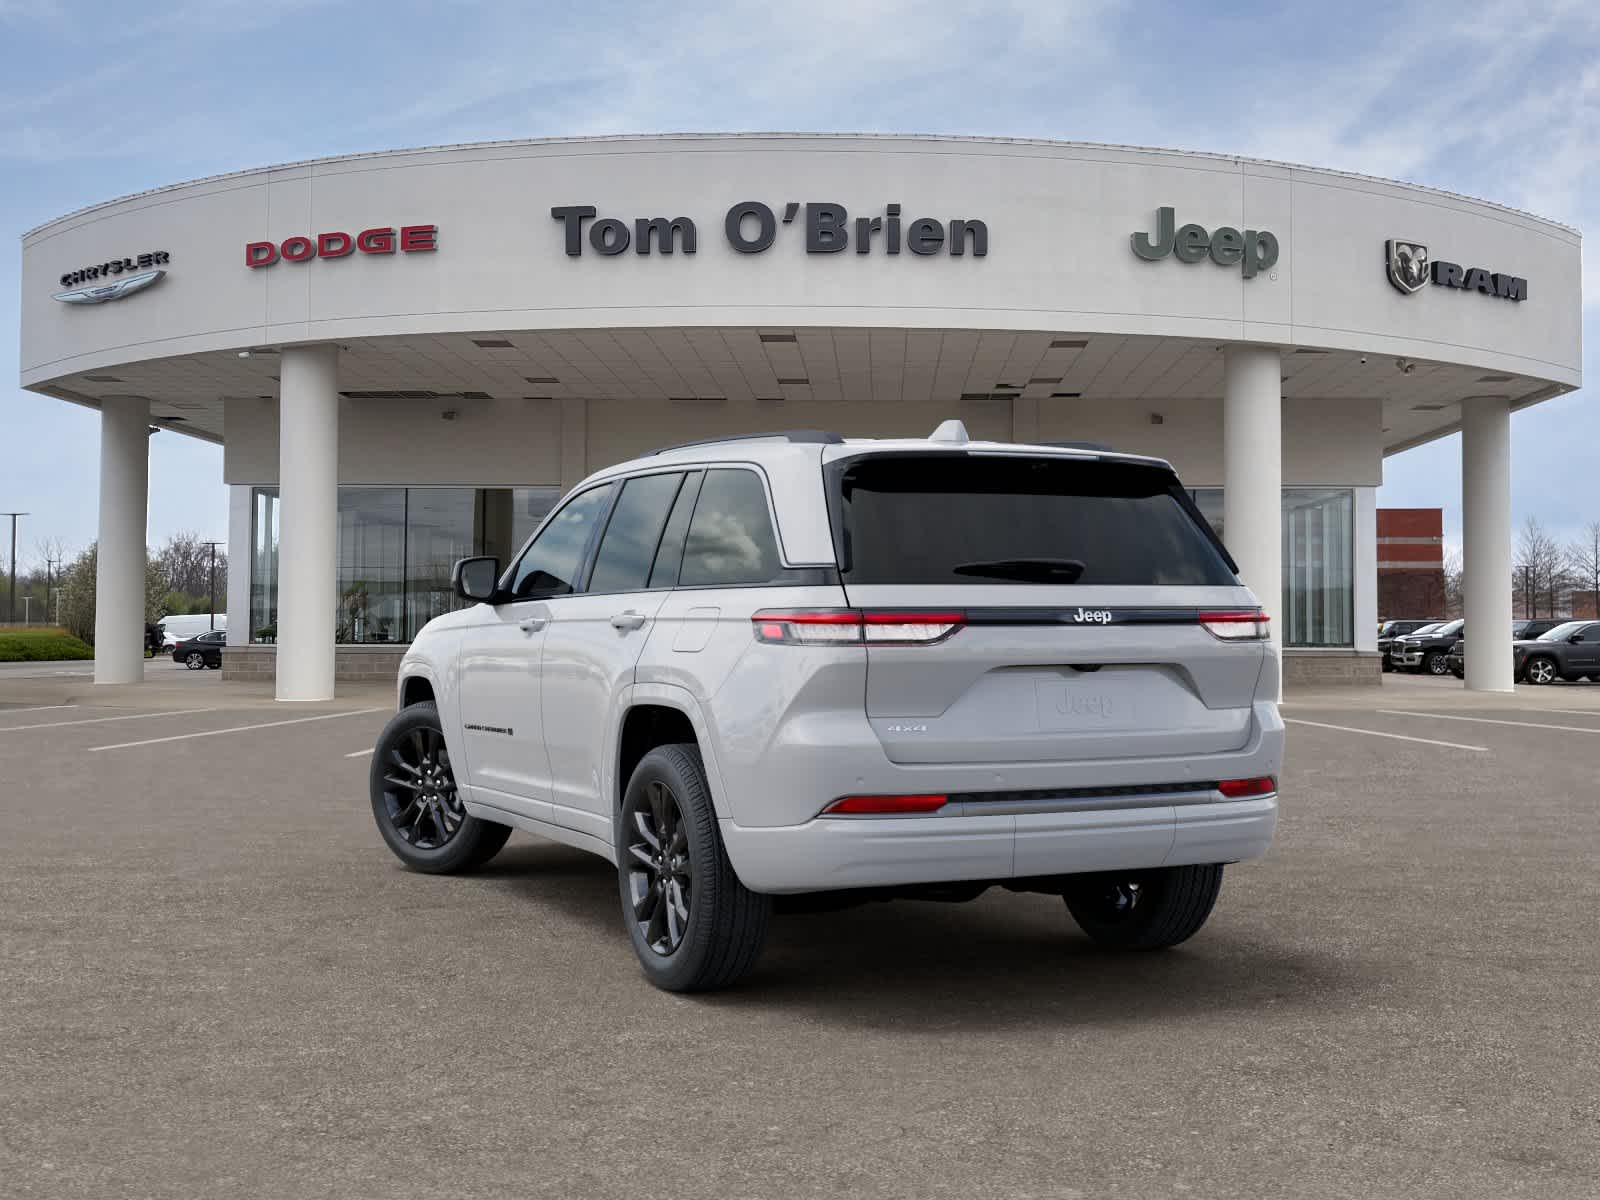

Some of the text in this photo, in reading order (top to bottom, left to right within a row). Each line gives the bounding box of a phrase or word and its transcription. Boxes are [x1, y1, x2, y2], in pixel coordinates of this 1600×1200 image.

[245, 224, 438, 269] DODGE
[551, 205, 697, 257] Tom
[1130, 206, 1280, 280] Jeep
[60, 250, 170, 287] CHRYSLER
[1431, 260, 1528, 302] RAM
[1072, 607, 1112, 625] Jeep
